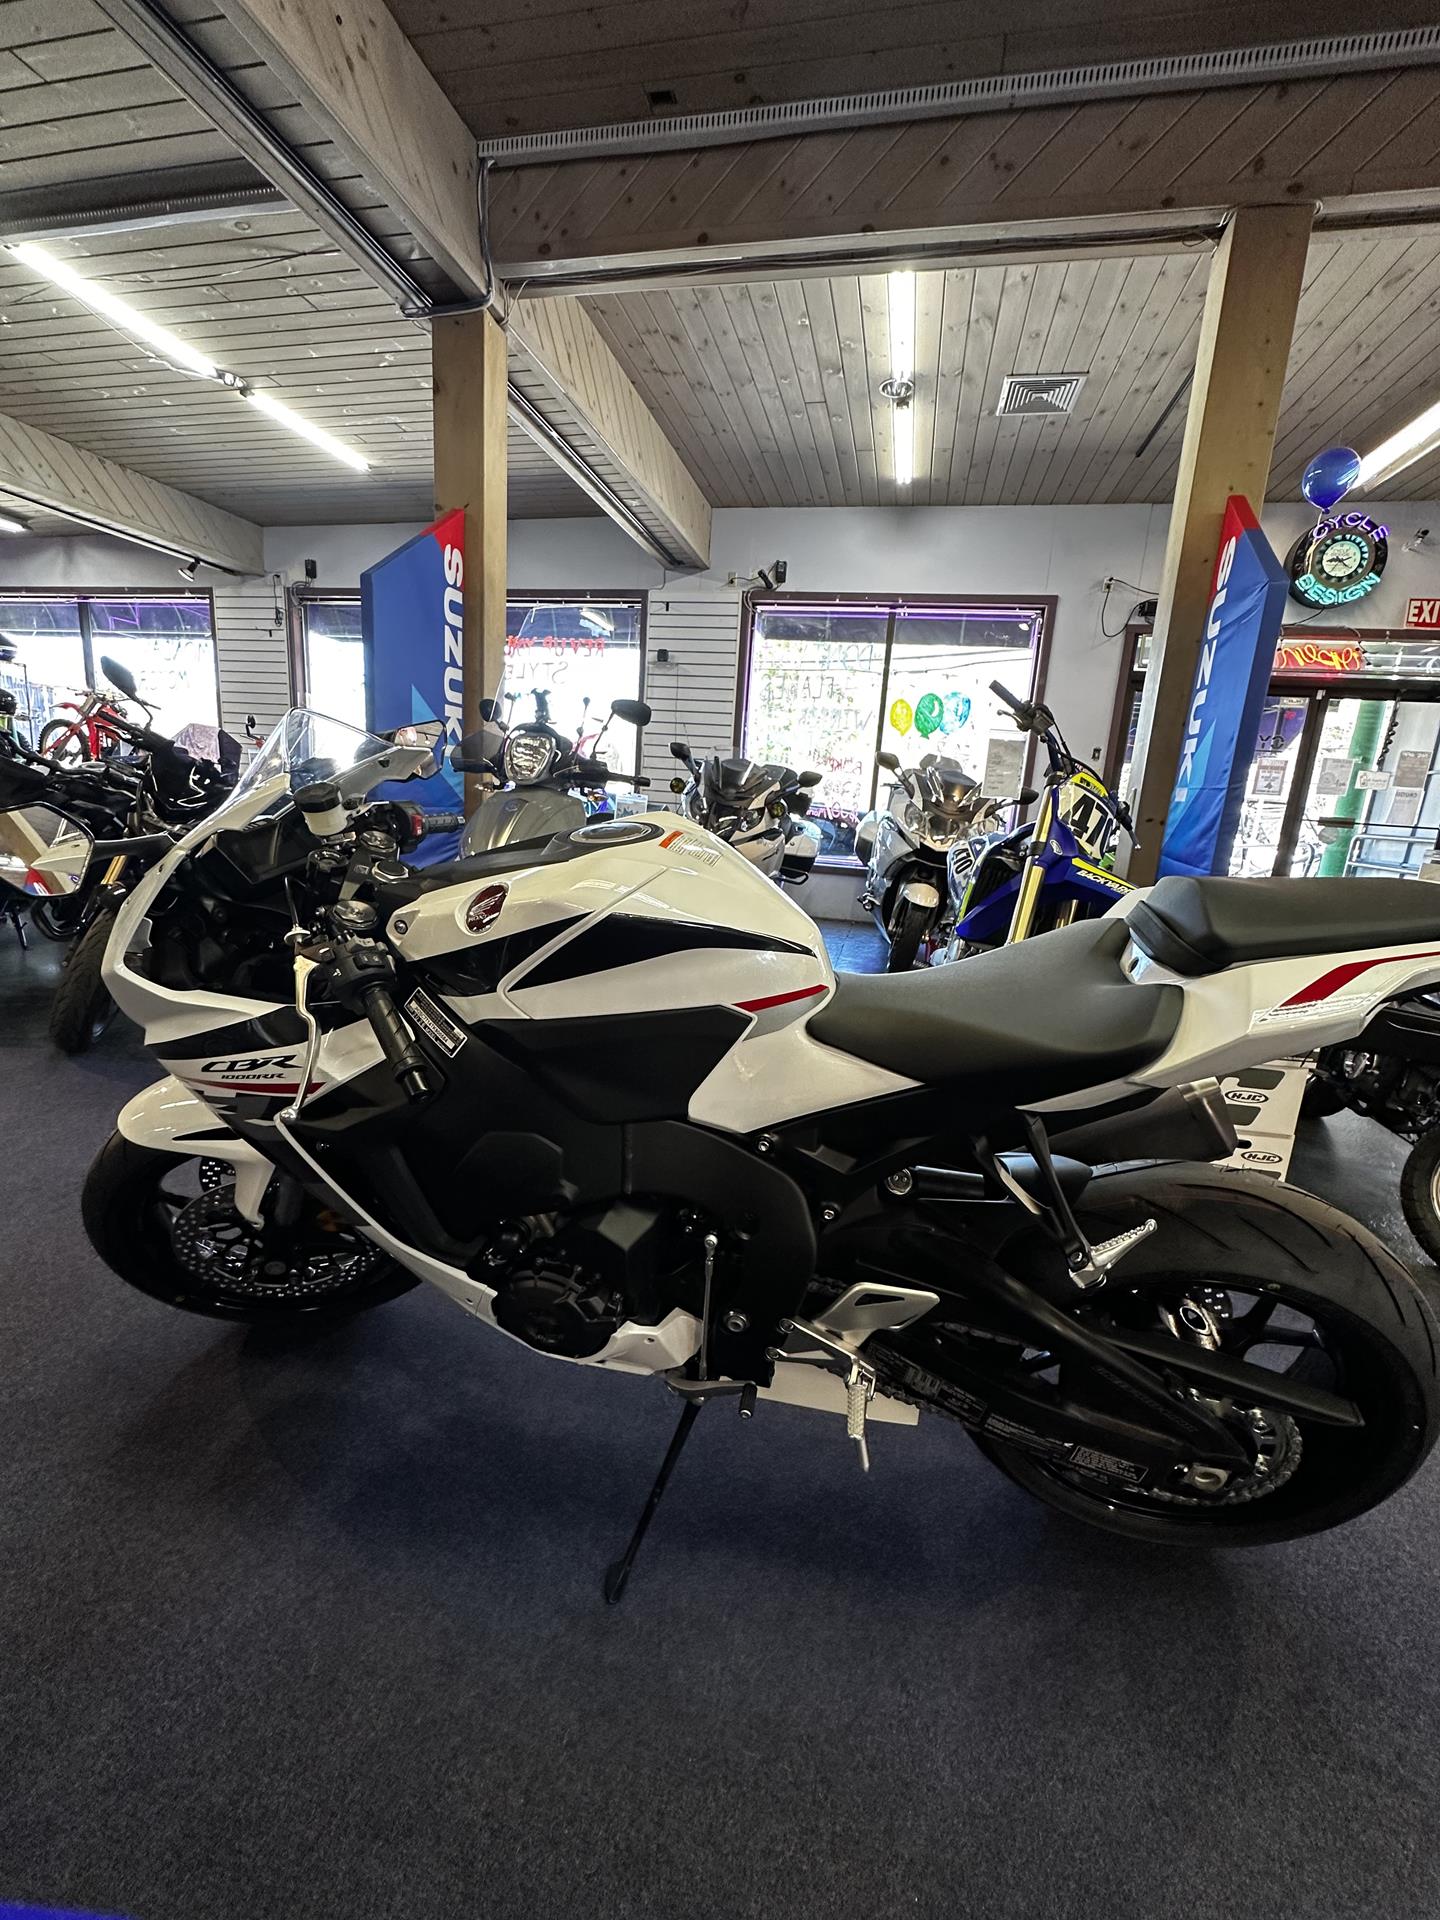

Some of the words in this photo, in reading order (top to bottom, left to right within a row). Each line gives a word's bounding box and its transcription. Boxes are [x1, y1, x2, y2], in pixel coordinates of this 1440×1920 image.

[1313, 511, 1389, 543] CYCLE
[1294, 572, 1381, 606] DESIGN
[1175, 535, 1236, 802] SUZUKI
[201, 1054, 304, 1072] CBR
[1231, 1092, 1262, 1102] HJC
[1247, 1153, 1277, 1162] HJC
